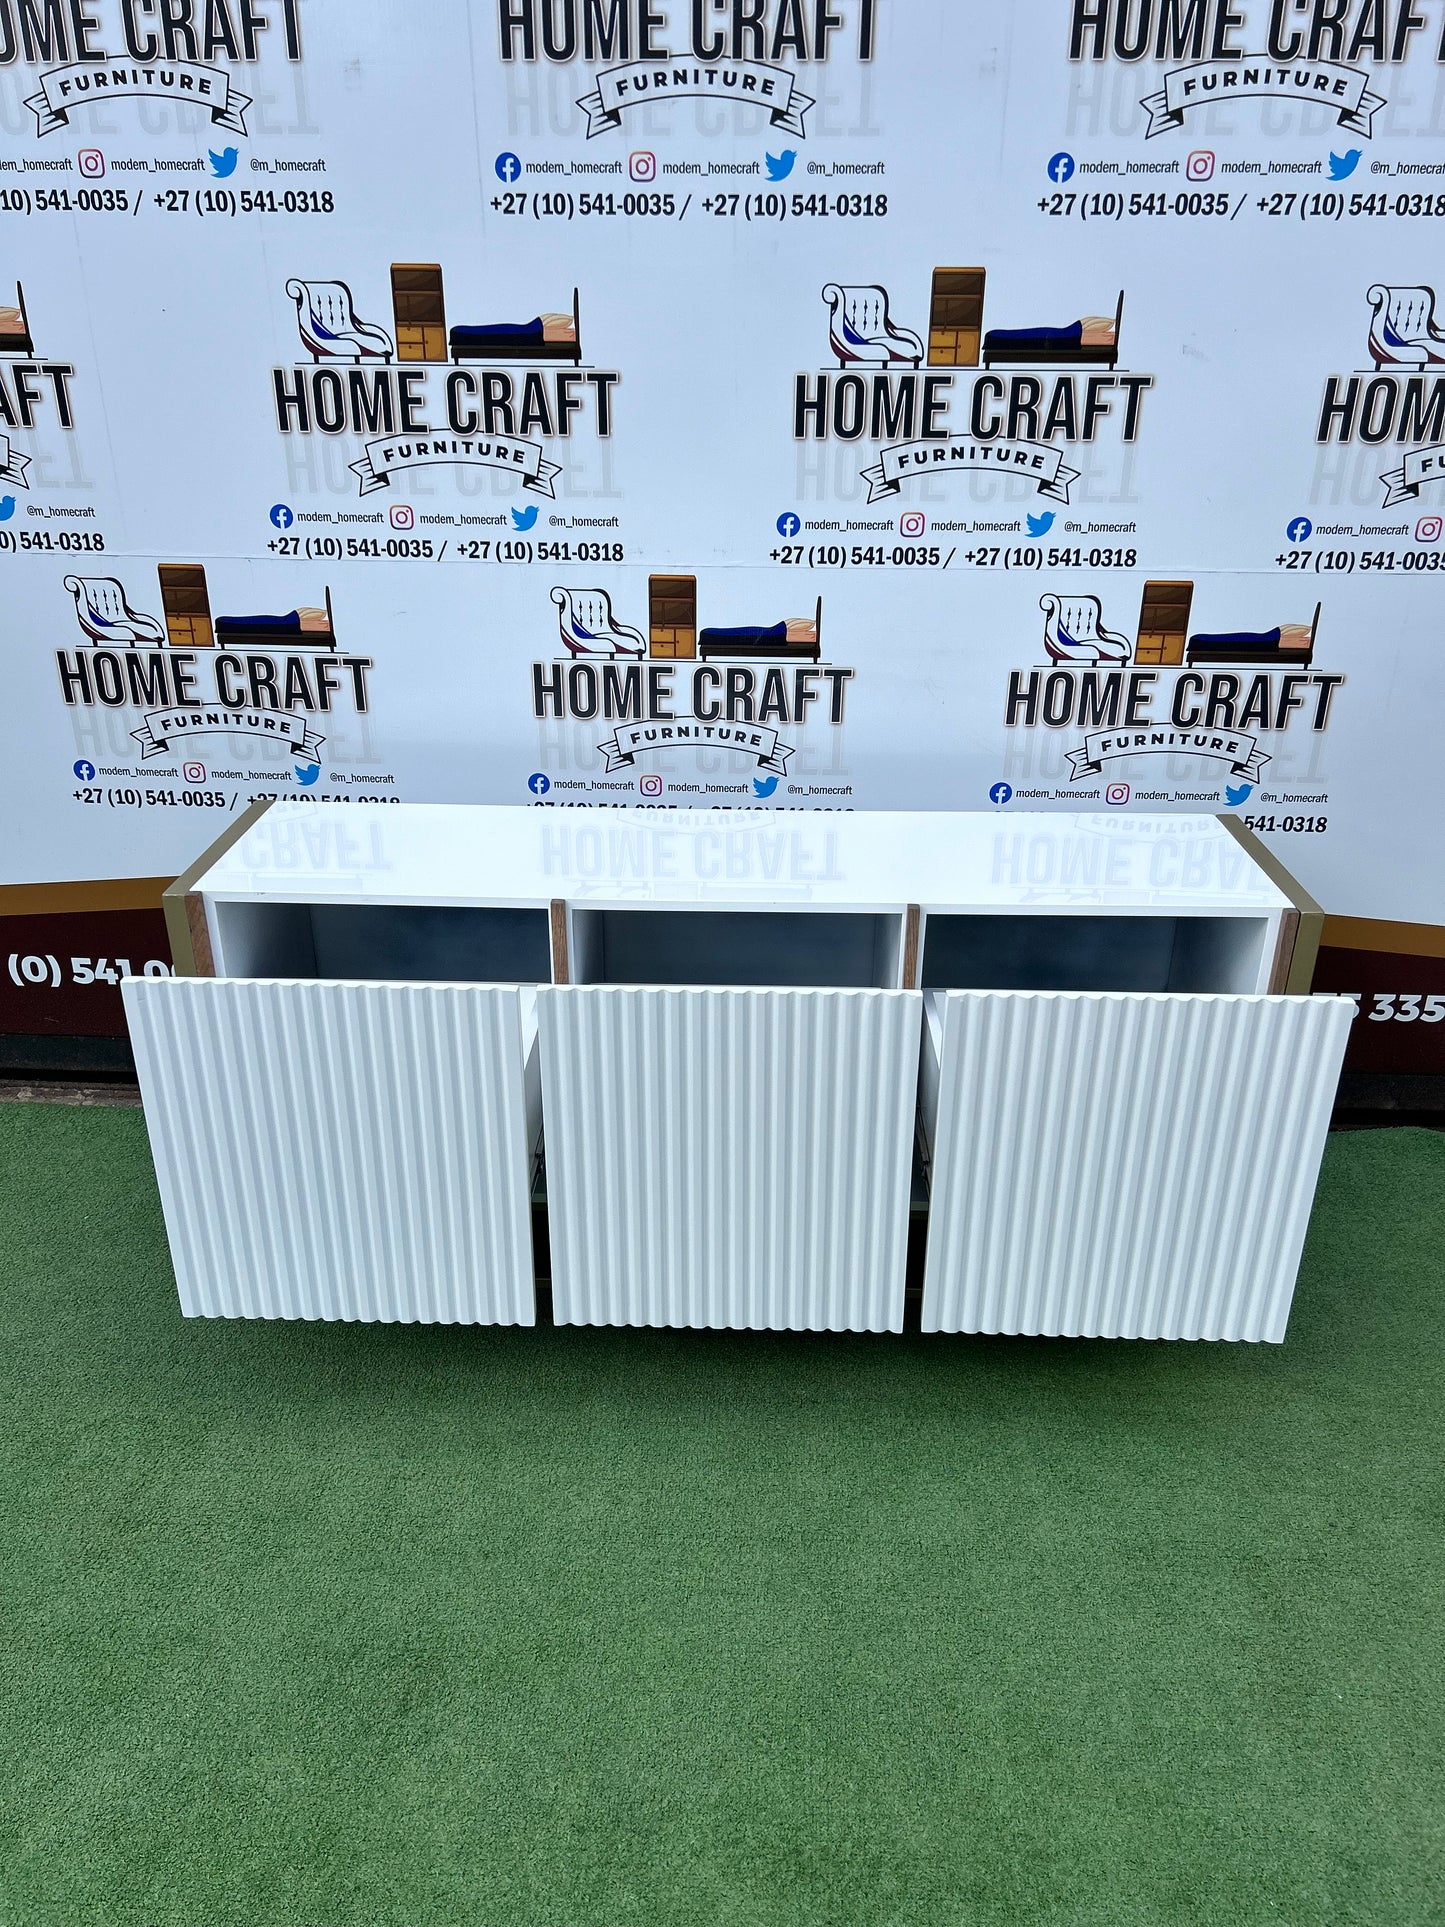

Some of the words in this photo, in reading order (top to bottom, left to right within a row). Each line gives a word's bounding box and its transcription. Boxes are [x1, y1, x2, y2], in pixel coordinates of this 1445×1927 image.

[500, 0, 669, 61] HOME
[1069, 0, 1244, 61] HOME
[1267, 0, 1445, 62] CRAF
[58, 69, 212, 96] FURNITURE
[616, 69, 776, 96] FURNITURE
[1183, 69, 1347, 96] FURNITURE
[251, 159, 326, 173] @m_homecraft
[807, 162, 884, 176] @m_homecraft
[35, 190, 128, 211] 541-0035
[154, 190, 189, 211] +27
[196, 190, 236, 216] (10)
[241, 191, 334, 212] 541-0318
[491, 193, 527, 214] +27
[533, 193, 573, 220] (10)
[579, 194, 674, 215] 541-0035
[702, 194, 739, 215] +27
[745, 195, 786, 221] (10)
[792, 195, 887, 216] 541-0318
[1038, 194, 1076, 215] +27
[1081, 194, 1123, 220] (10)
[1129, 193, 1229, 215] 541-0035
[1257, 194, 1297, 215] +27
[1301, 194, 1344, 220] (10)
[1349, 194, 1445, 216] 541-0318
[273, 369, 430, 434] HOME
[446, 370, 619, 437] CRAFT
[794, 374, 951, 440] HOME
[970, 375, 1153, 441] CRAFT
[383, 441, 525, 463] FURNITURE
[897, 446, 1045, 469] FURNITURE
[27, 506, 95, 518] @m_homecraft
[549, 516, 618, 528] @m_homecraft
[1065, 522, 1136, 533] @m_homecraft
[20, 532, 104, 551] 541-0318
[268, 537, 299, 555] +27
[306, 538, 342, 560] (10)
[347, 539, 433, 557] 541-0035
[458, 541, 490, 558] +27
[496, 542, 532, 563] (10)
[538, 543, 623, 561] 541-0318
[770, 546, 804, 564] +27
[809, 547, 846, 568] (10)
[851, 547, 939, 565] 541-0035
[965, 548, 1000, 565] +27
[1005, 548, 1042, 569] (10)
[1048, 548, 1136, 567] 541-0318
[1276, 551, 1312, 569] +27
[1316, 551, 1355, 573] (10)
[56, 650, 202, 706] HOME
[214, 654, 371, 713] CRAFT
[532, 663, 675, 719] HOME
[692, 667, 854, 723] CRAFT
[1004, 671, 1158, 727] HOME
[1171, 672, 1344, 730] CRAFT
[160, 713, 291, 734] FURNITURE
[630, 726, 762, 746] FURNITURE
[1101, 733, 1239, 754] FURNITURE
[330, 773, 394, 783] @m_homecraft
[73, 788, 102, 803] +27
[108, 789, 142, 808] (10)
[146, 790, 225, 807] 541-0035
[788, 785, 852, 795] @m_homecraft
[1261, 793, 1328, 803] @m_homecraft
[8, 954, 62, 988] (0)
